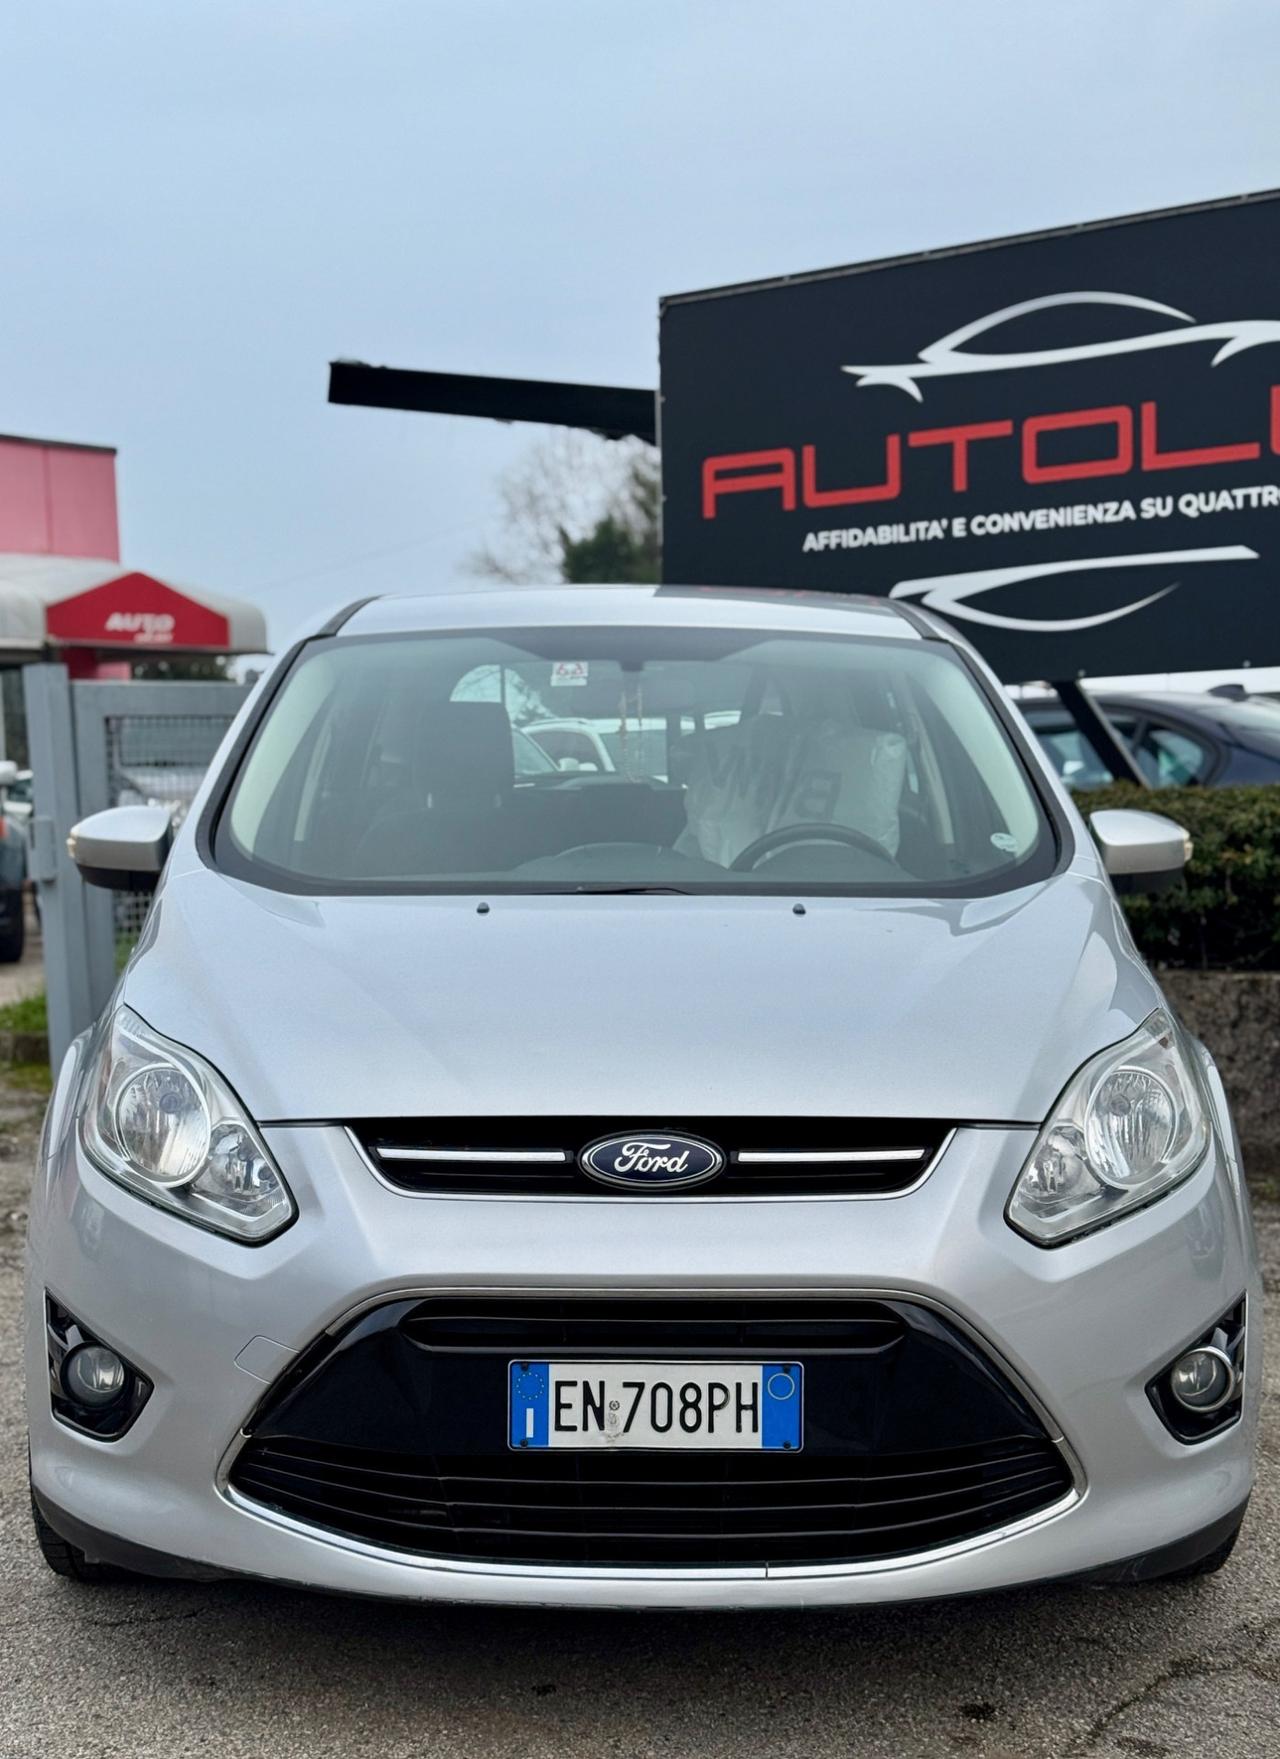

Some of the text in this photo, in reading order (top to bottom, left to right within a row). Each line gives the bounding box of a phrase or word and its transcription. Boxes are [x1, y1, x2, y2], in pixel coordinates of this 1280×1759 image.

[702, 384, 1280, 519] AUTOL
[802, 484, 1280, 552] AFFIDABILITA' E CONVENIENZA SU QUATTR
[104, 612, 176, 634] AUTO
[613, 1142, 690, 1173] Ford
